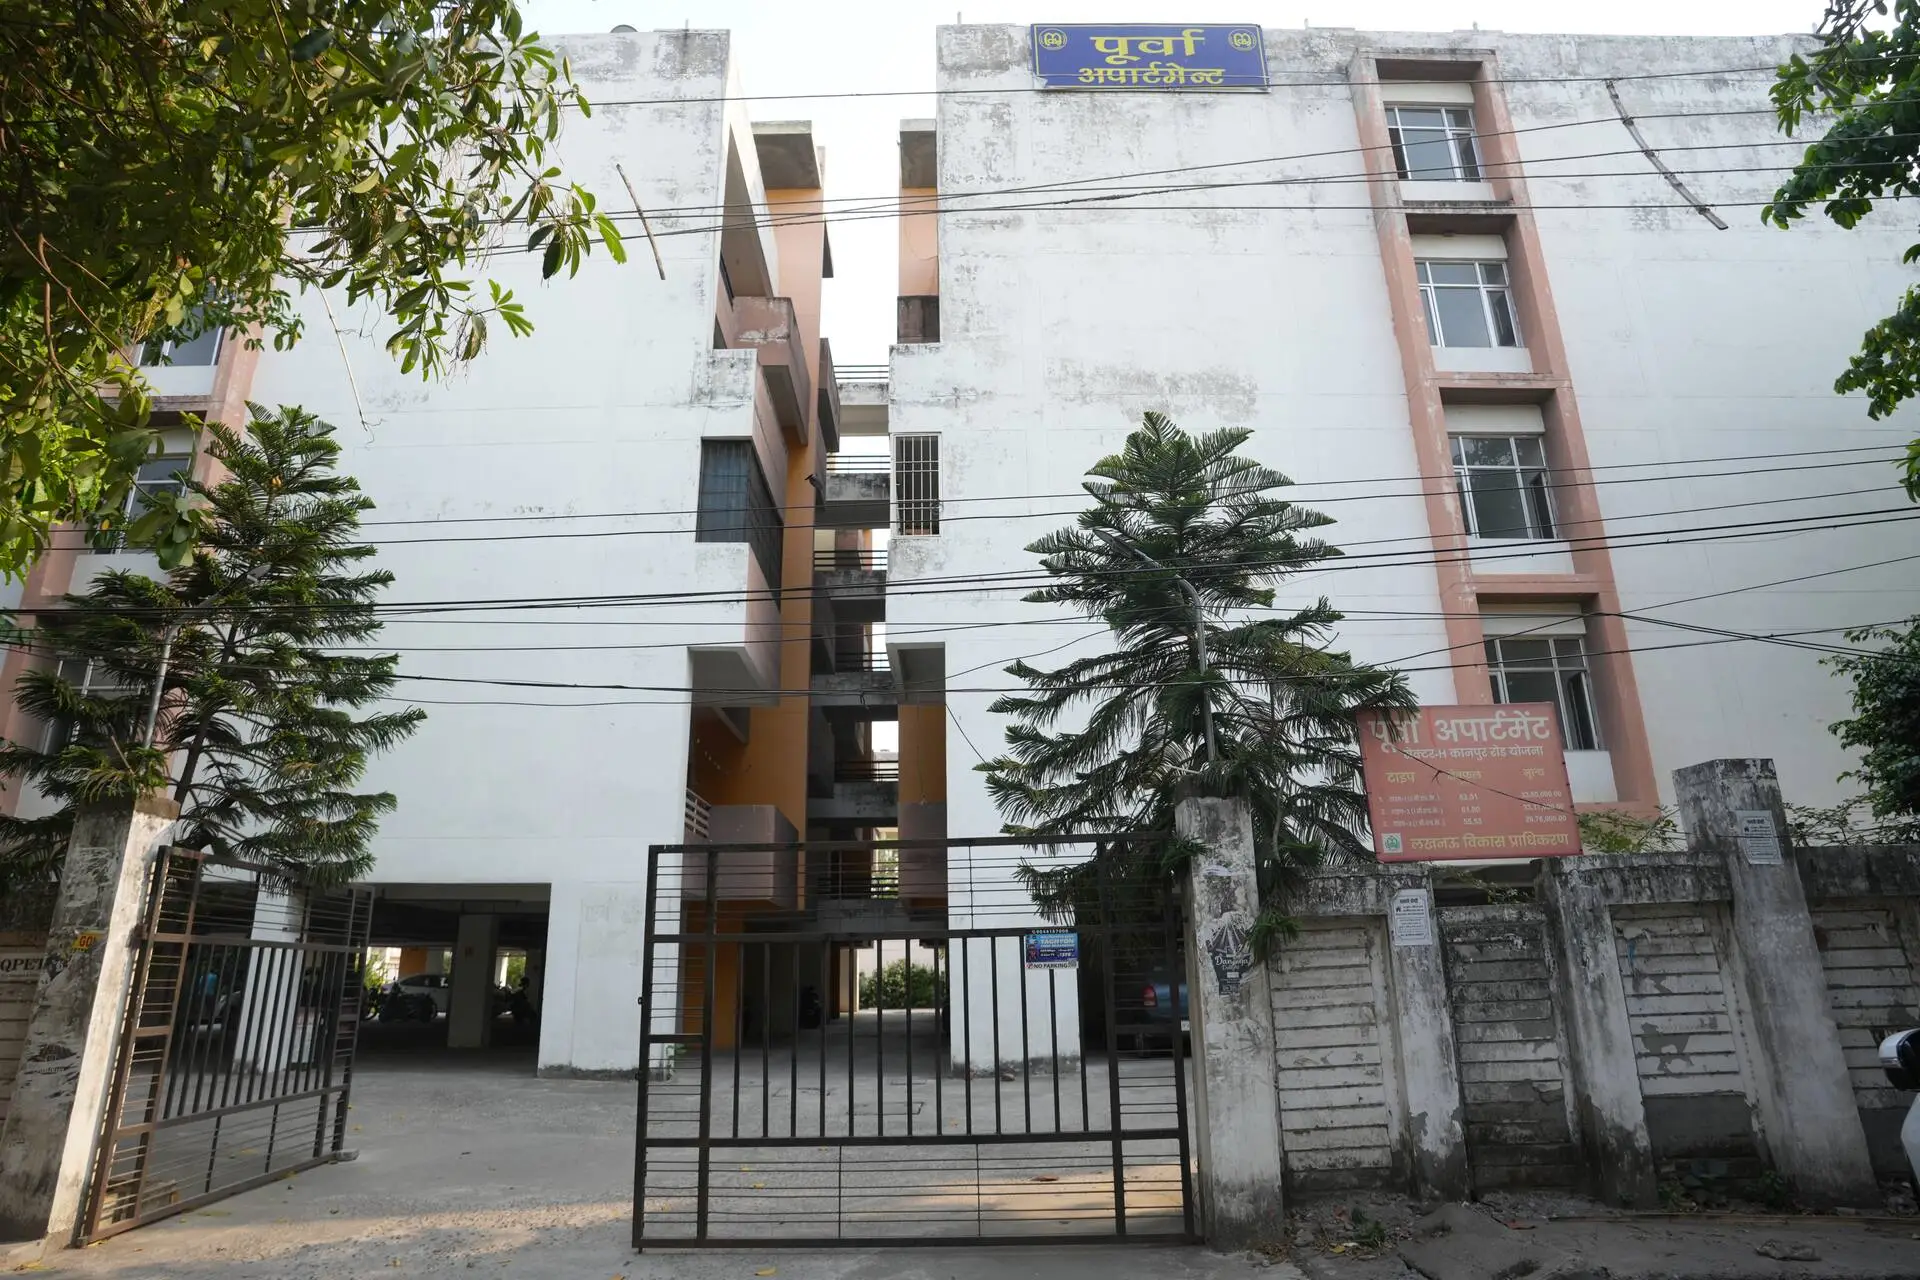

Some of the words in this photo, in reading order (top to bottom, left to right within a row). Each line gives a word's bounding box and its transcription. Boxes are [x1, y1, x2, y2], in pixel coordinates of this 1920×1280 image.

[1090, 28, 1205, 65] पूर्वा
[1078, 61, 1226, 84] अपार्टमेन्ट
[1434, 710, 1550, 743] अपार्टमेंट
[1507, 745, 1544, 757] योजना
[1409, 836, 1460, 850] लखनऊ
[1462, 832, 1506, 849] विकास
[1508, 832, 1569, 848] प्राधिकरण
